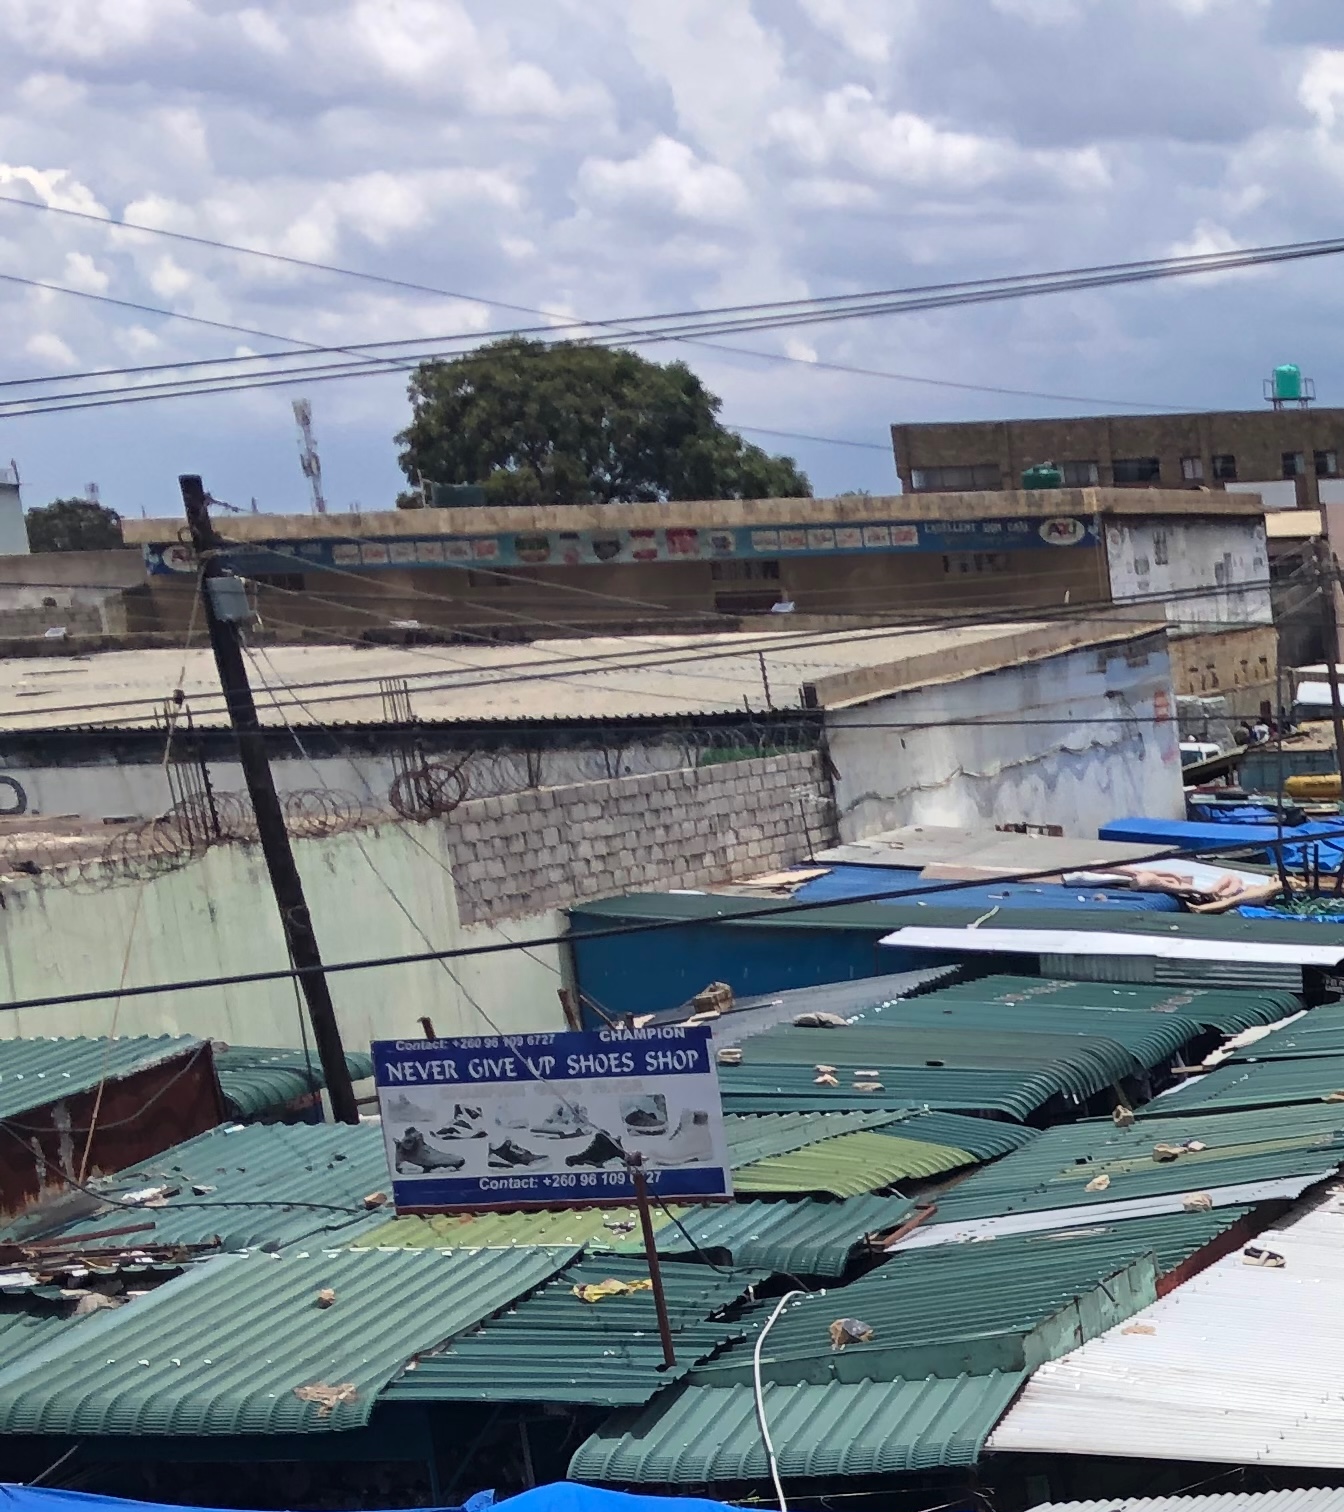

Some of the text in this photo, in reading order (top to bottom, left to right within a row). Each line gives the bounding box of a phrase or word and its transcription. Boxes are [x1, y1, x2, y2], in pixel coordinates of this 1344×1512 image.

[394, 1040, 448, 1051] Contact:
[453, 1037, 480, 1049] +260
[483, 1036, 498, 1048] 96
[526, 1033, 556, 1046] 6727
[598, 1028, 686, 1042] CHAMPION
[384, 1049, 699, 1081] NEVER GIVE UP SHOES SHOP
[479, 1176, 539, 1191] Contact:
[542, 1173, 576, 1188] +260
[580, 1172, 597, 1186] 96
[601, 1171, 625, 1185] 109
